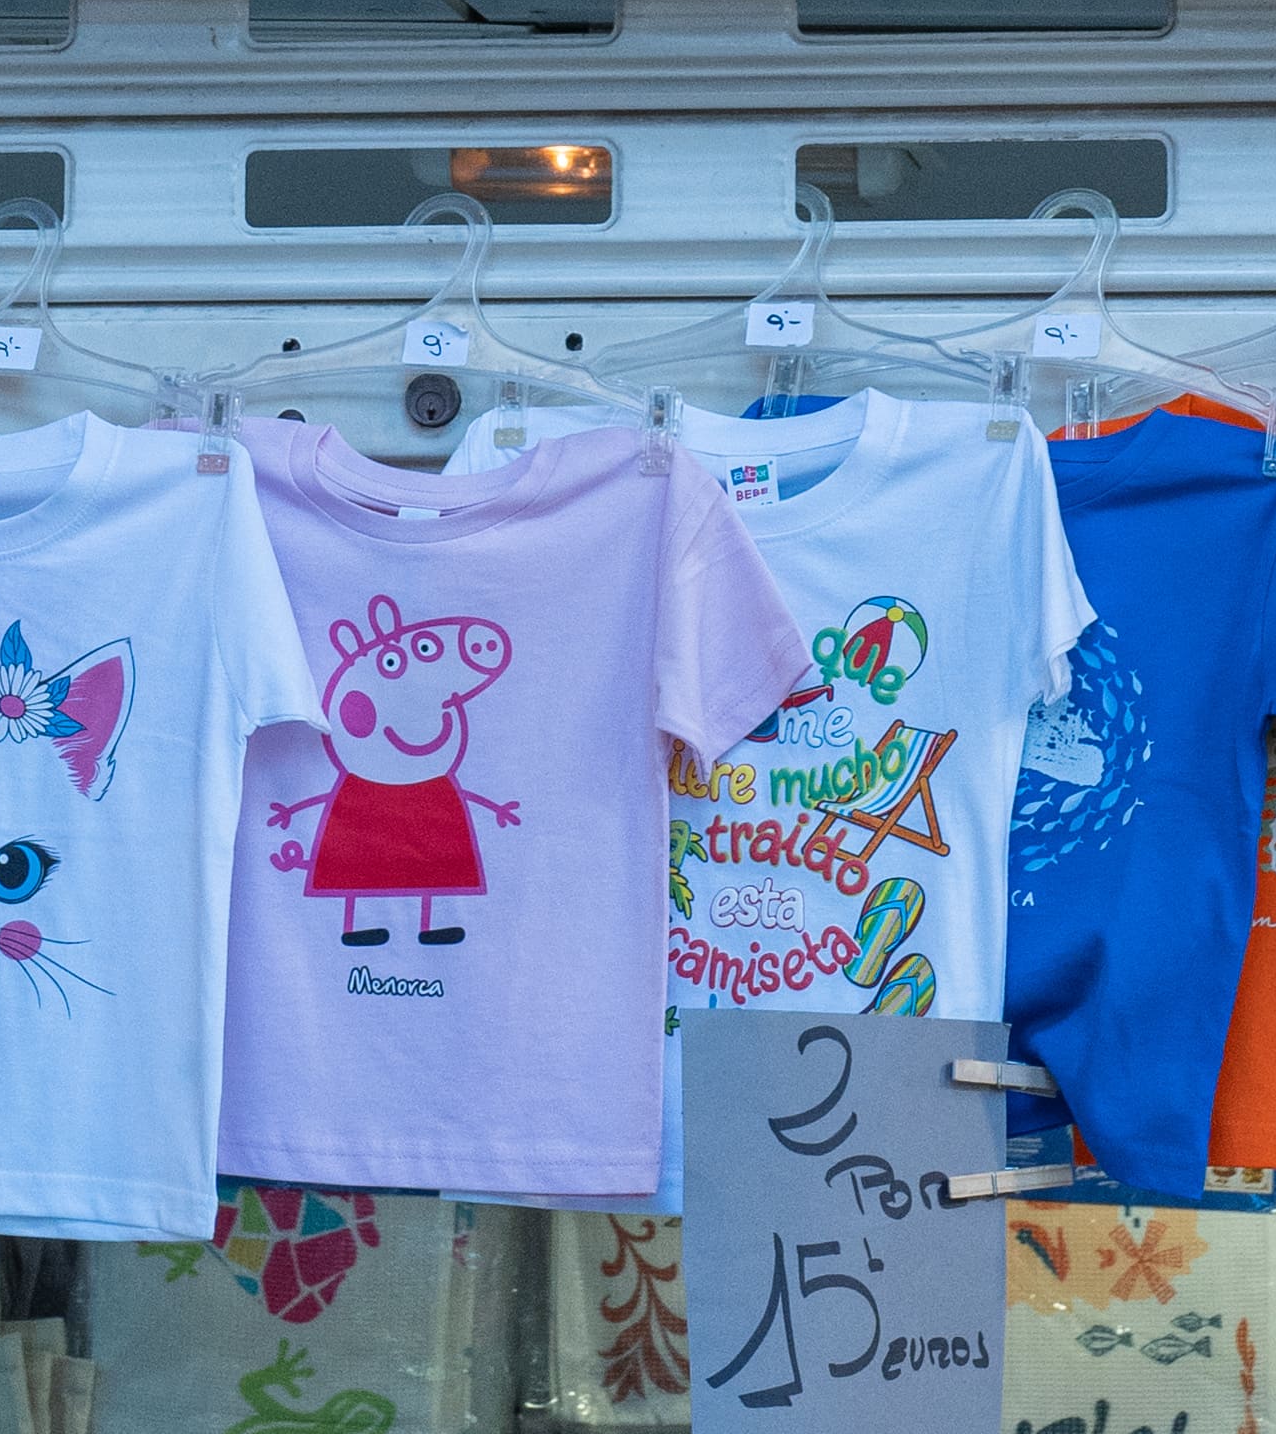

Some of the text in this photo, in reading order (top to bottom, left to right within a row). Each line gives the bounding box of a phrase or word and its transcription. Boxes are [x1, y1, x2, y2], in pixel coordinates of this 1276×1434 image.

[812, 626, 908, 706] que
[776, 706, 855, 749] me
[769, 735, 912, 811] mucho
[704, 812, 871, 897] traido
[709, 877, 807, 933] esta
[347, 965, 445, 998] Menorca
[768, 1024, 858, 1157] 2
